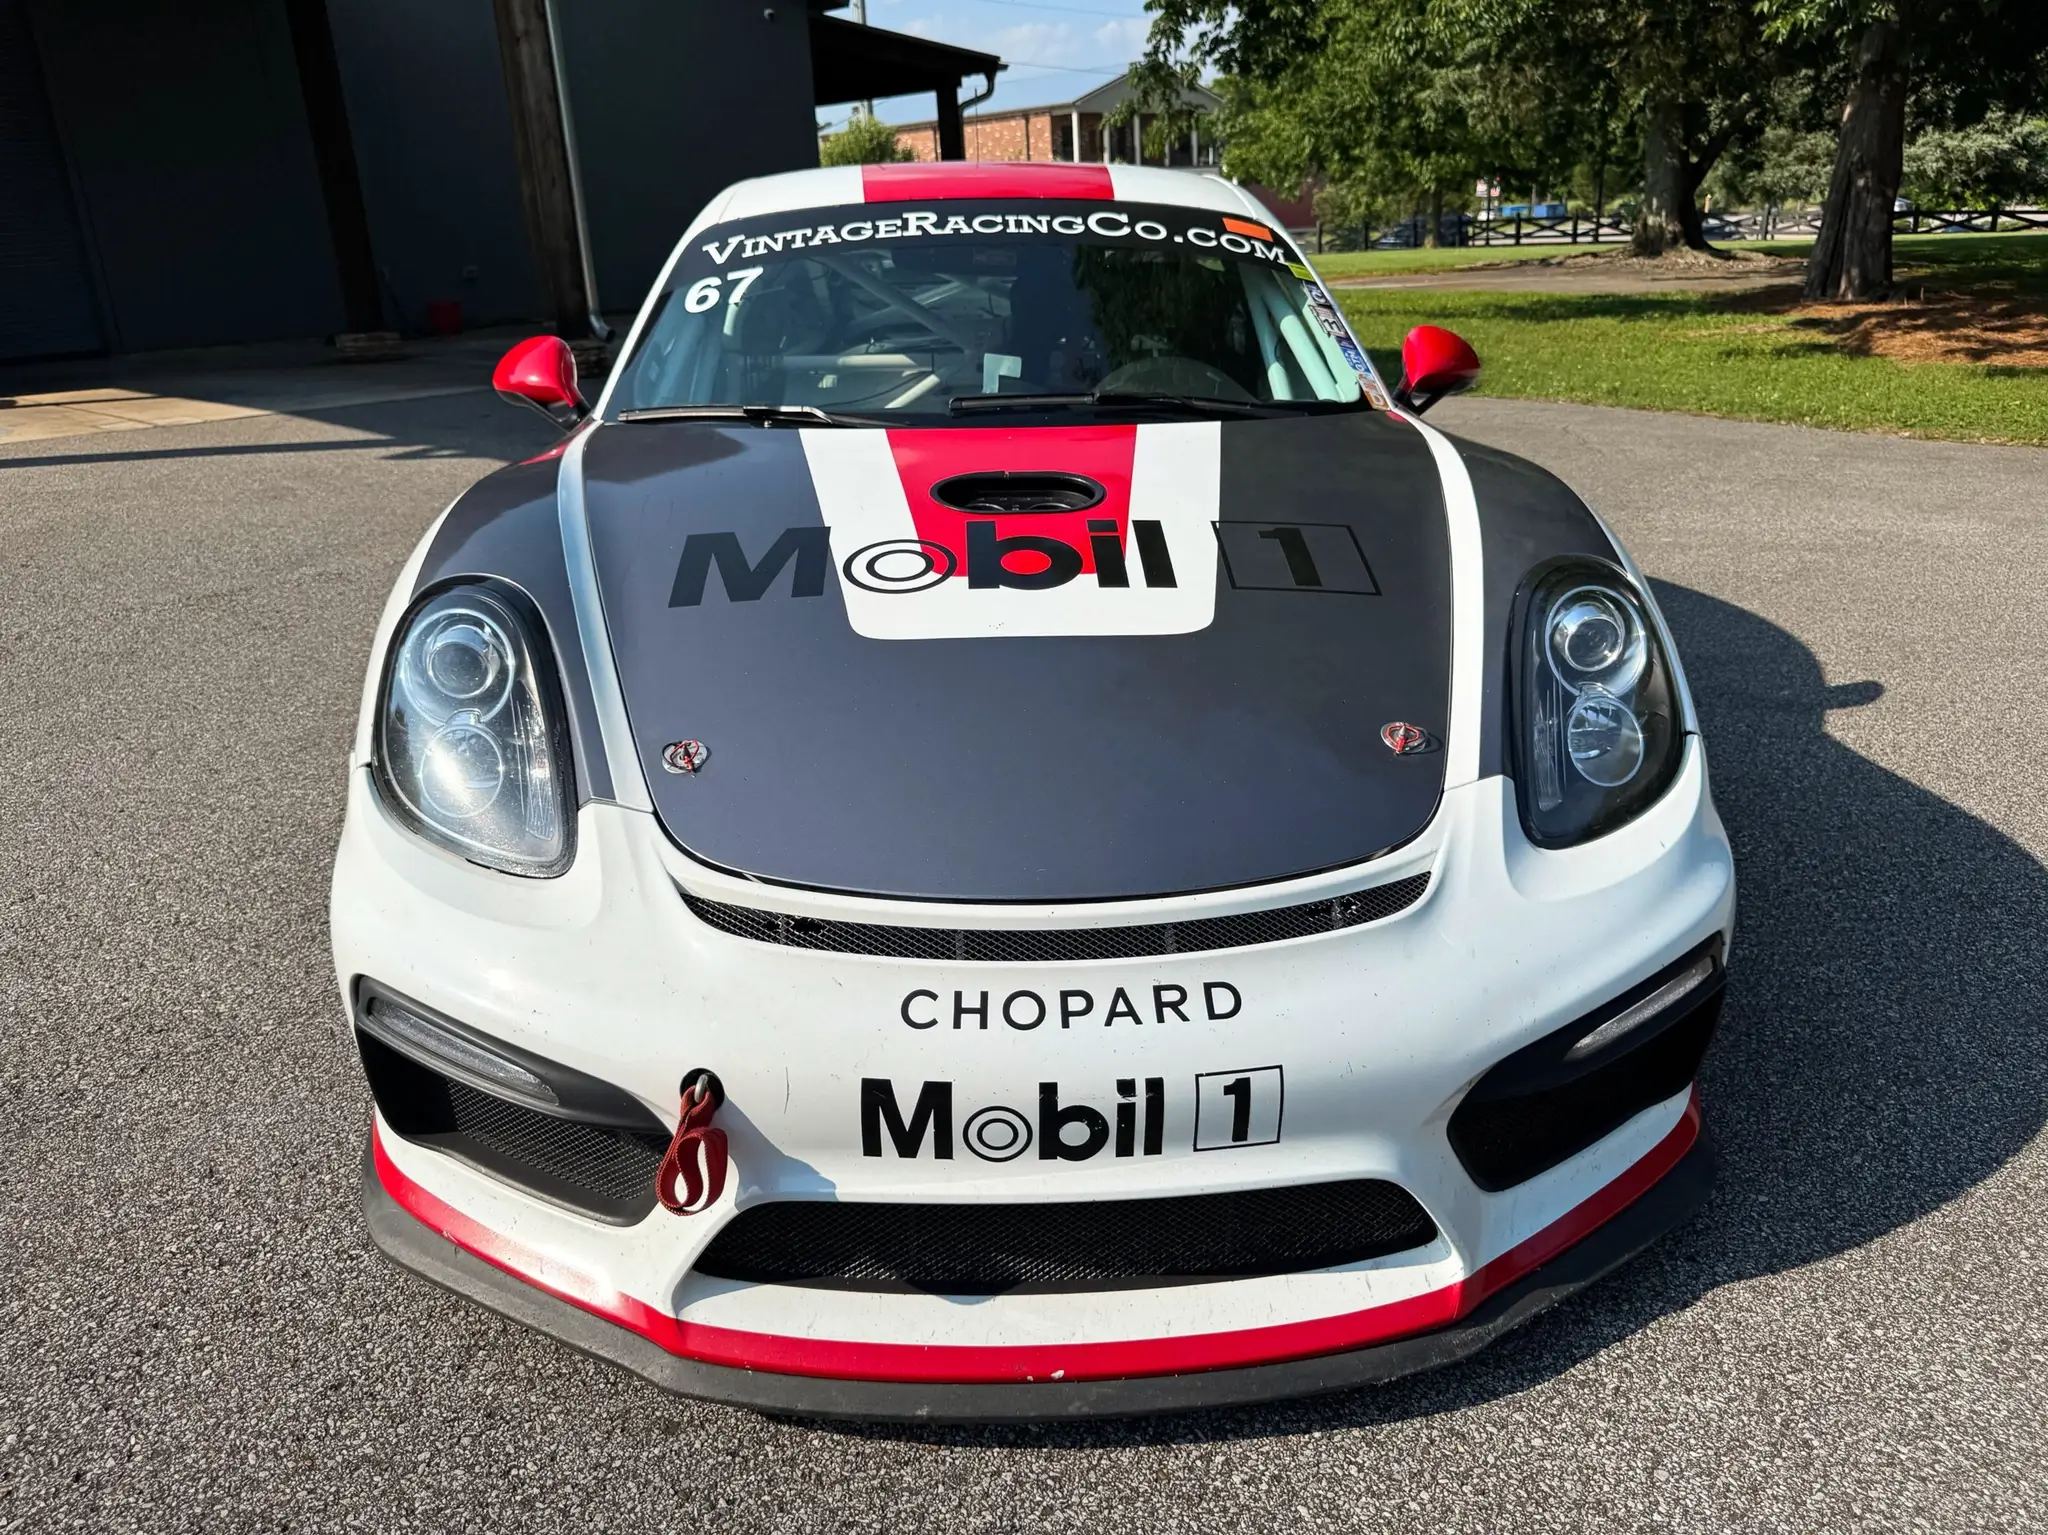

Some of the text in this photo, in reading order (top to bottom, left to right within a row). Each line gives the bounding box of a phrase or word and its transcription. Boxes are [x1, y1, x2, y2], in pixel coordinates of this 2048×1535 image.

[683, 267, 763, 314] 67
[668, 519, 1323, 608] Mobil 1
[900, 981, 1242, 1030] CHOPARD
[860, 1077, 1252, 1163] Mobil 1
